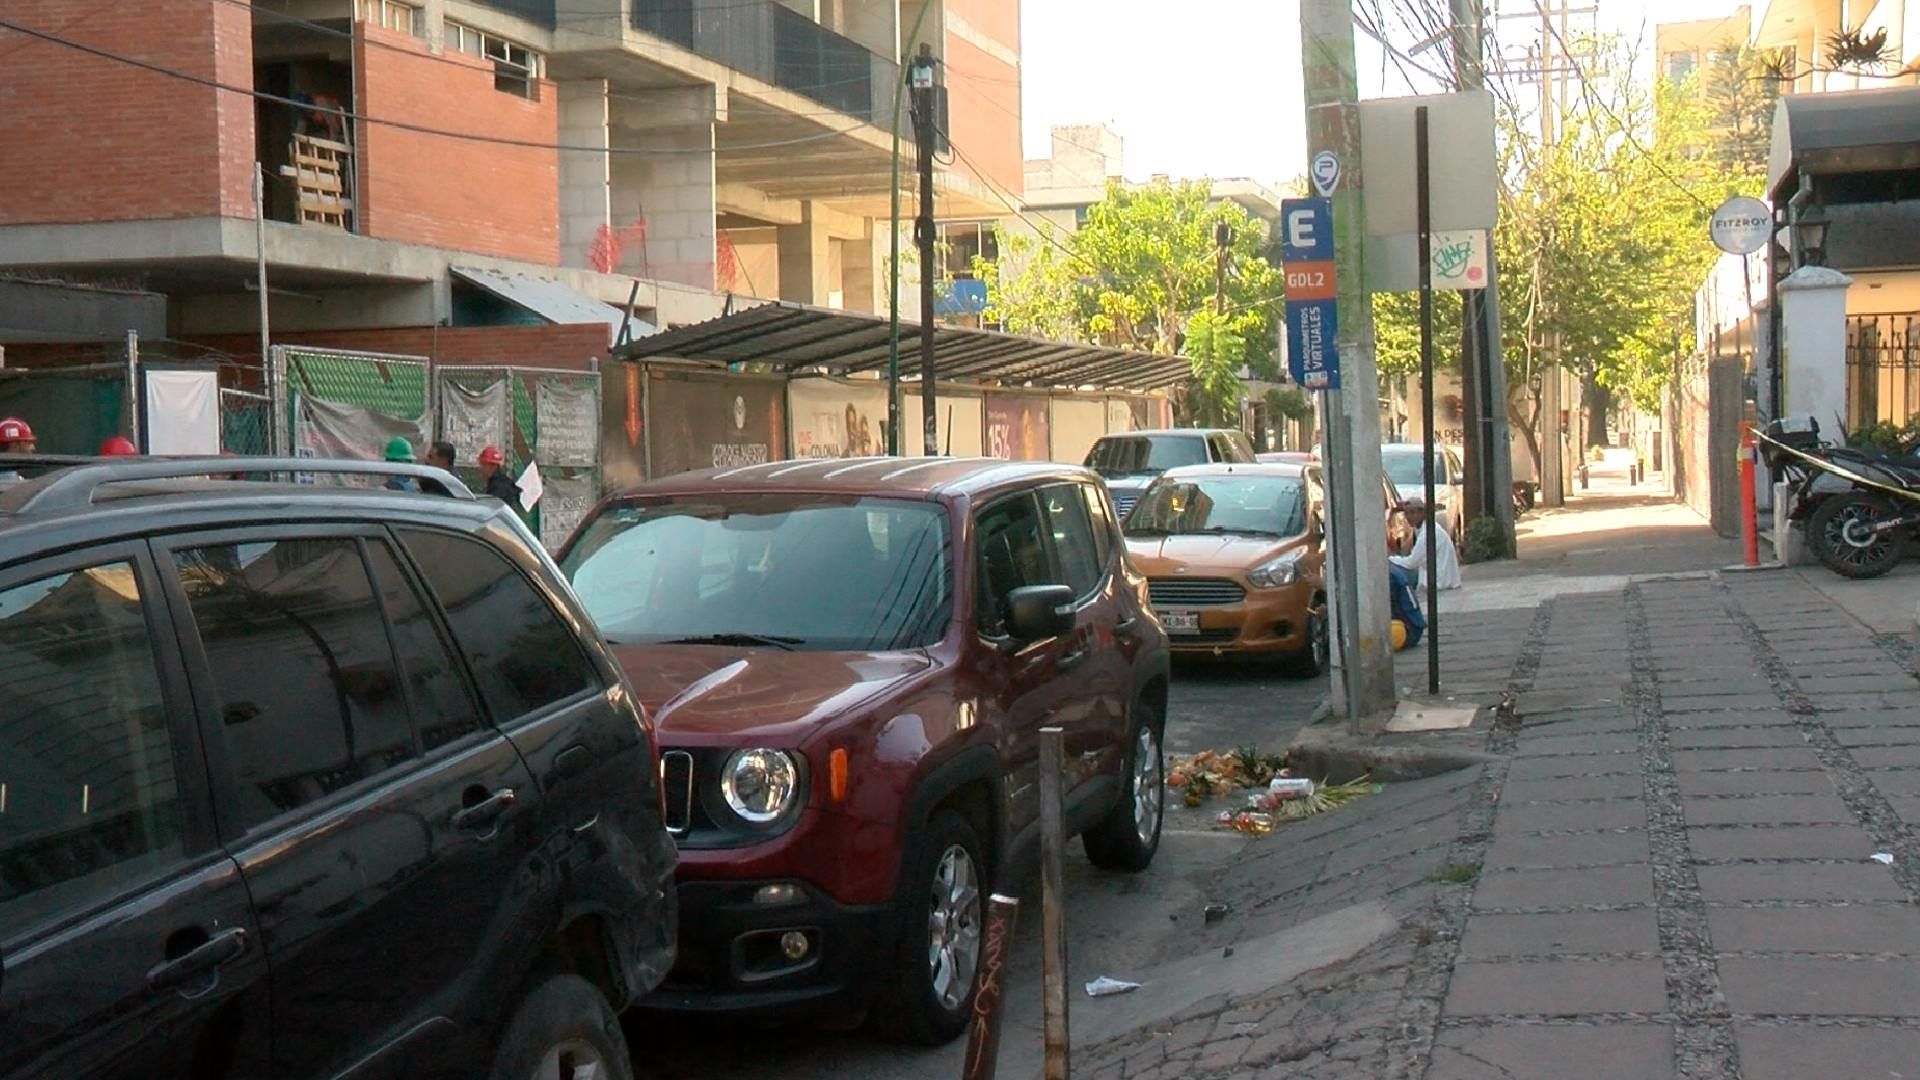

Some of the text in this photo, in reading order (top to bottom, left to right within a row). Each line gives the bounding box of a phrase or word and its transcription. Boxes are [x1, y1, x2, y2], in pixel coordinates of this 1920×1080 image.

[1288, 209, 1317, 248] E
[1715, 216, 1768, 229] FITZROY
[1287, 271, 1325, 288] GDL2
[1309, 305, 1323, 370] VIRTUALES
[988, 423, 1011, 461] 15%
